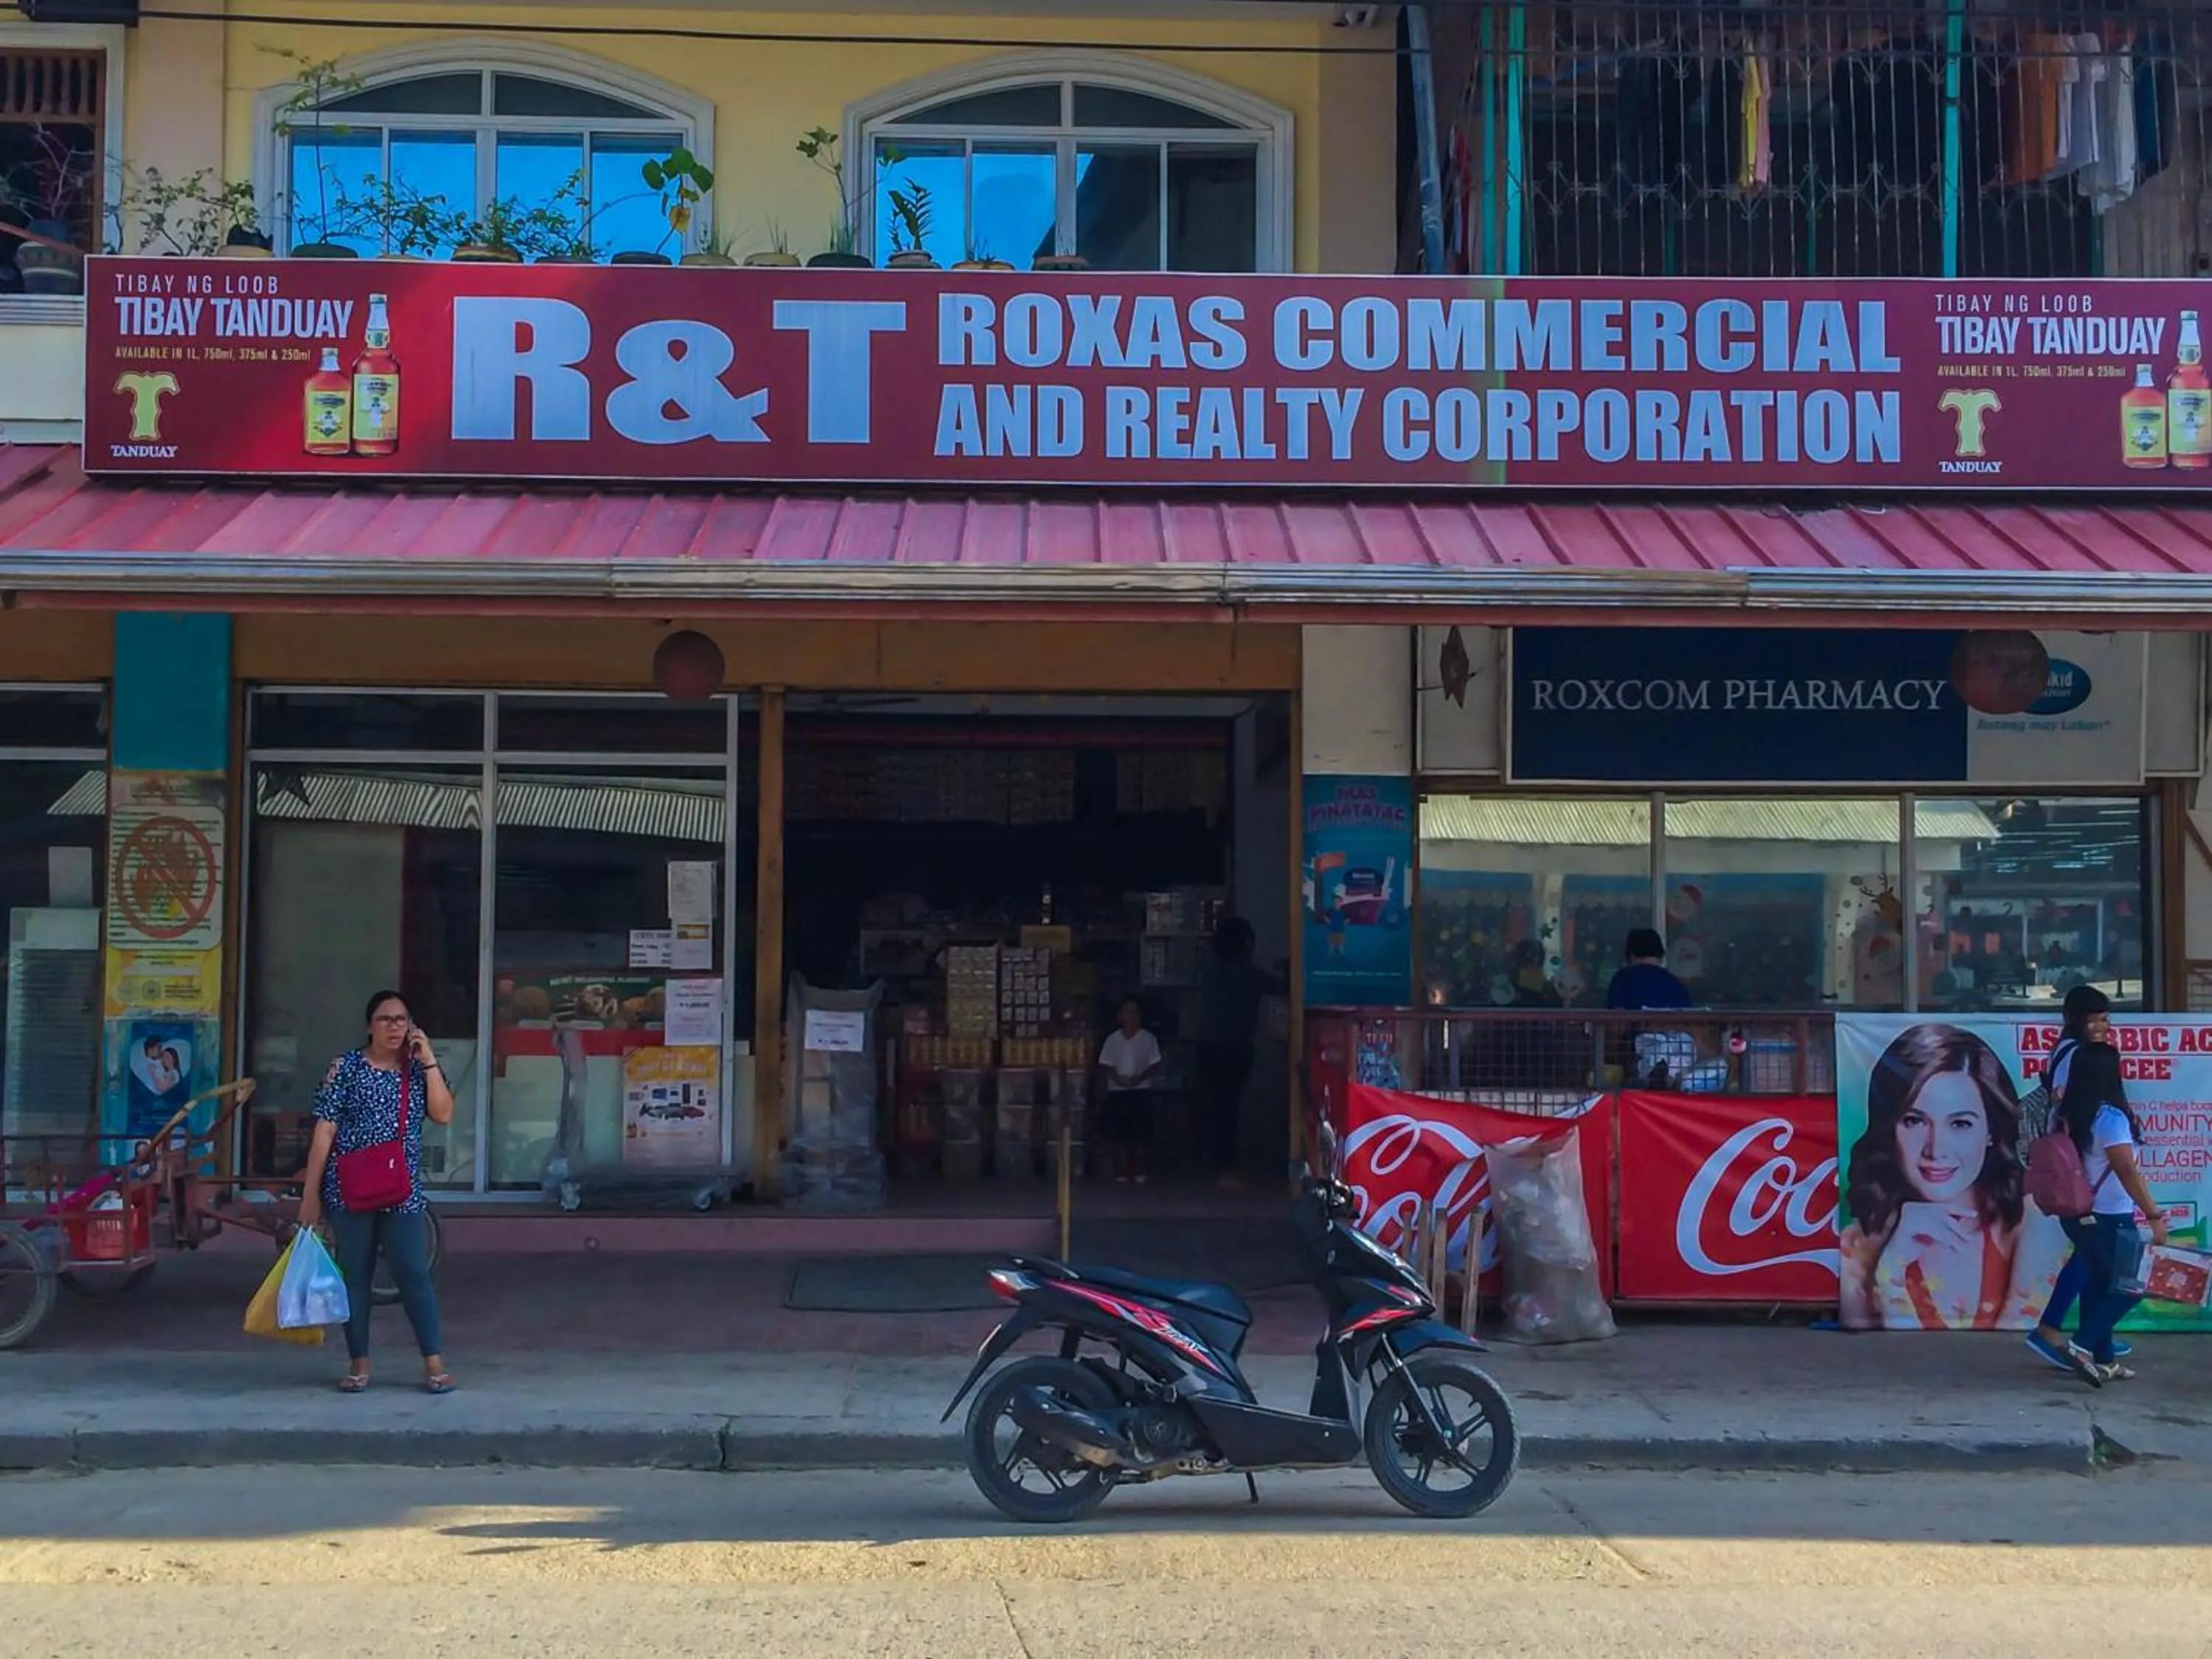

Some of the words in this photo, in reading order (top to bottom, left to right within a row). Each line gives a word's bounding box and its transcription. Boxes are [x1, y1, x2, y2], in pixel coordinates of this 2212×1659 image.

[116, 274, 173, 293] TIBAY
[187, 275, 212, 293] NG
[226, 276, 279, 293] LOOB
[1935, 294, 1992, 312] TIBAY
[2005, 295, 2028, 313] NG
[2042, 295, 2093, 313] LOOB
[114, 296, 204, 336] TIBAY
[211, 298, 354, 338] TANDUAY
[939, 293, 1247, 370] ROXAS
[1273, 296, 1901, 373] COMMERCIAL
[1935, 316, 2020, 354] TIBAY
[2027, 317, 2166, 355] TANDUAY
[115, 347, 167, 359] AVAILABLE
[172, 347, 182, 359] IN
[238, 348, 268, 360] 375ml
[271, 349, 277, 360] &
[281, 349, 310, 361] 250ml
[452, 296, 906, 444] R&T
[1938, 365, 1989, 377] AVAILABLE
[1992, 365, 2002, 377] IN
[933, 383, 1084, 457] AND
[1106, 386, 1364, 460] REALTY
[1382, 387, 1901, 463] CORPORATION
[110, 446, 178, 458] TANDUAY
[1939, 461, 2003, 473] TANDUAY
[1532, 679, 1711, 710] ROXCOM
[1723, 679, 1947, 710] PHARMACY
[2021, 1027, 2169, 1052] ASBIC
[2178, 1028, 2212, 1052] AC
[2135, 1114, 2212, 1132] MUNITY
[2136, 1150, 2212, 1168] LLAGEN
[2138, 1169, 2201, 1182] oduction
